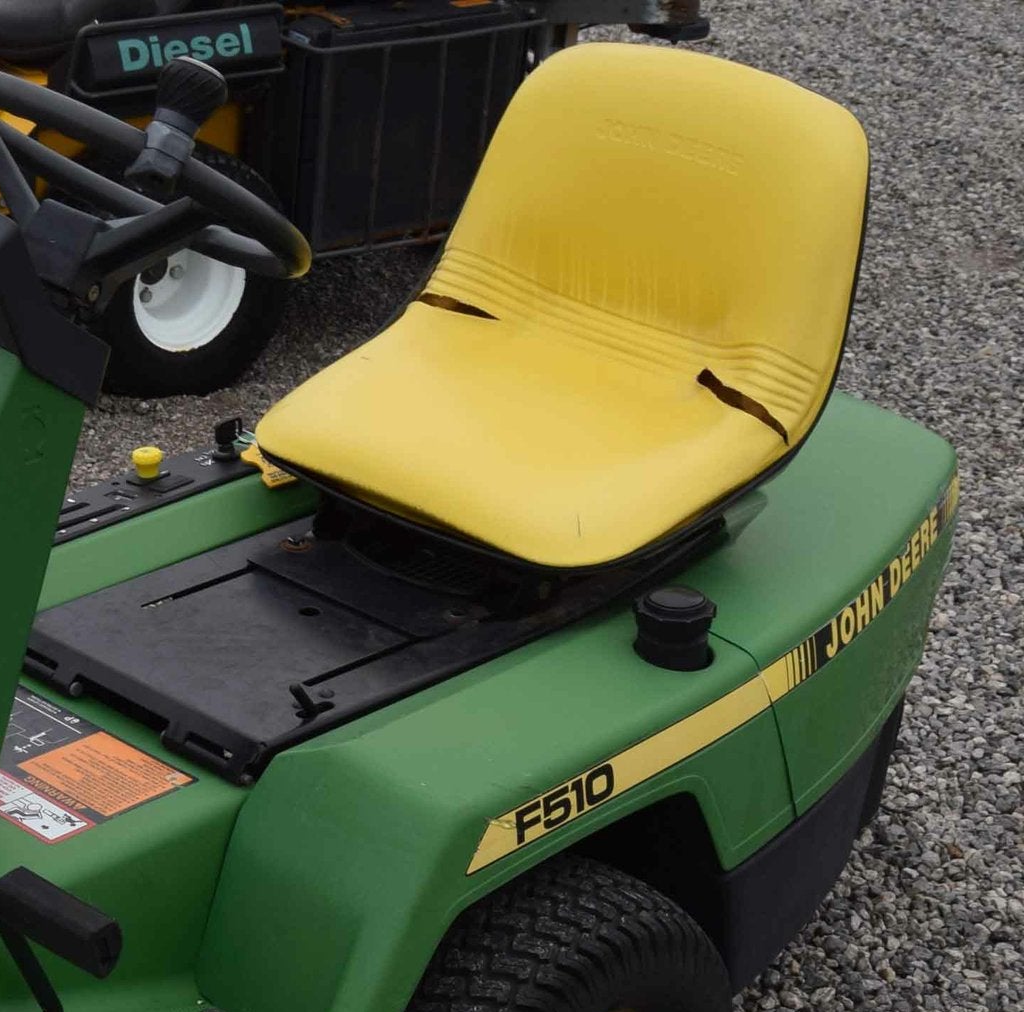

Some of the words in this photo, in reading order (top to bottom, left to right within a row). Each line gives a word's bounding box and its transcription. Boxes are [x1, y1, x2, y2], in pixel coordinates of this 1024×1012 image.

[117, 23, 253, 71] Diesel
[826, 575, 885, 659] JOHN
[889, 505, 939, 598] DEERE
[515, 763, 615, 846] F510
